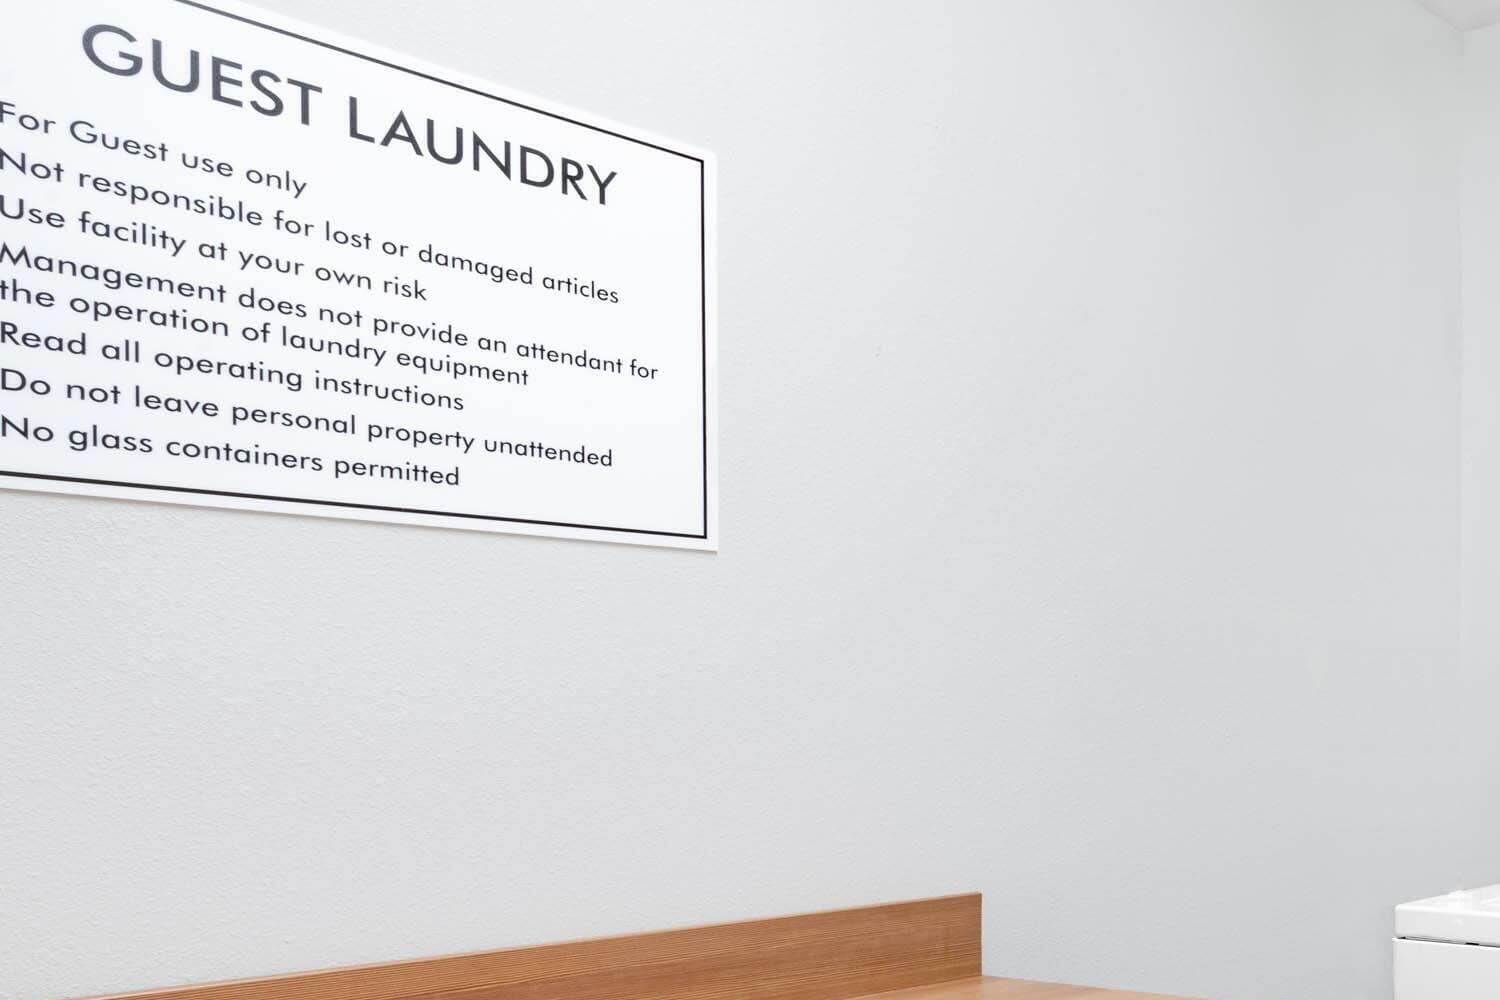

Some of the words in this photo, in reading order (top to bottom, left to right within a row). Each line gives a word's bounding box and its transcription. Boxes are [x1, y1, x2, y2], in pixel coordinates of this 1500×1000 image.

[0, 100, 56, 134] For
[69, 120, 169, 162] Guest
[181, 153, 234, 177] use
[245, 169, 307, 199] only
[82, 24, 323, 126] GUEST
[349, 95, 617, 206] LAUNDRY
[0, 147, 65, 183] Not
[79, 172, 263, 226] responsible
[273, 209, 315, 237] for
[325, 220, 372, 250] lost
[381, 241, 409, 257] or
[418, 243, 533, 285] damaged
[542, 276, 619, 304] articles
[0, 194, 65, 229] Use
[78, 210, 187, 257] facility
[198, 242, 228, 261] at
[238, 250, 305, 276] your
[315, 267, 372, 290] own
[383, 276, 427, 301] risk
[0, 242, 227, 303] Management
[238, 287, 307, 318] does
[319, 307, 363, 328] not
[373, 317, 468, 347] provide
[477, 337, 507, 354] an
[516, 343, 623, 374] attendant
[629, 358, 659, 380] for
[0, 278, 55, 308] the
[69, 297, 229, 337] operation
[241, 322, 271, 343] of
[282, 325, 387, 367] laundry
[396, 352, 529, 386] equipment
[0, 320, 87, 356] Read
[101, 339, 140, 363] all
[154, 352, 302, 392] operating
[315, 369, 464, 411] instructions
[0, 367, 51, 396] Do
[66, 384, 121, 405] not
[135, 384, 219, 417] leave
[232, 406, 356, 435] personal
[367, 424, 475, 454] property
[484, 439, 613, 467] unattended
[1, 414, 54, 442] No
[68, 424, 153, 453] glass
[165, 441, 323, 472] containers
[334, 460, 459, 486] permitted
